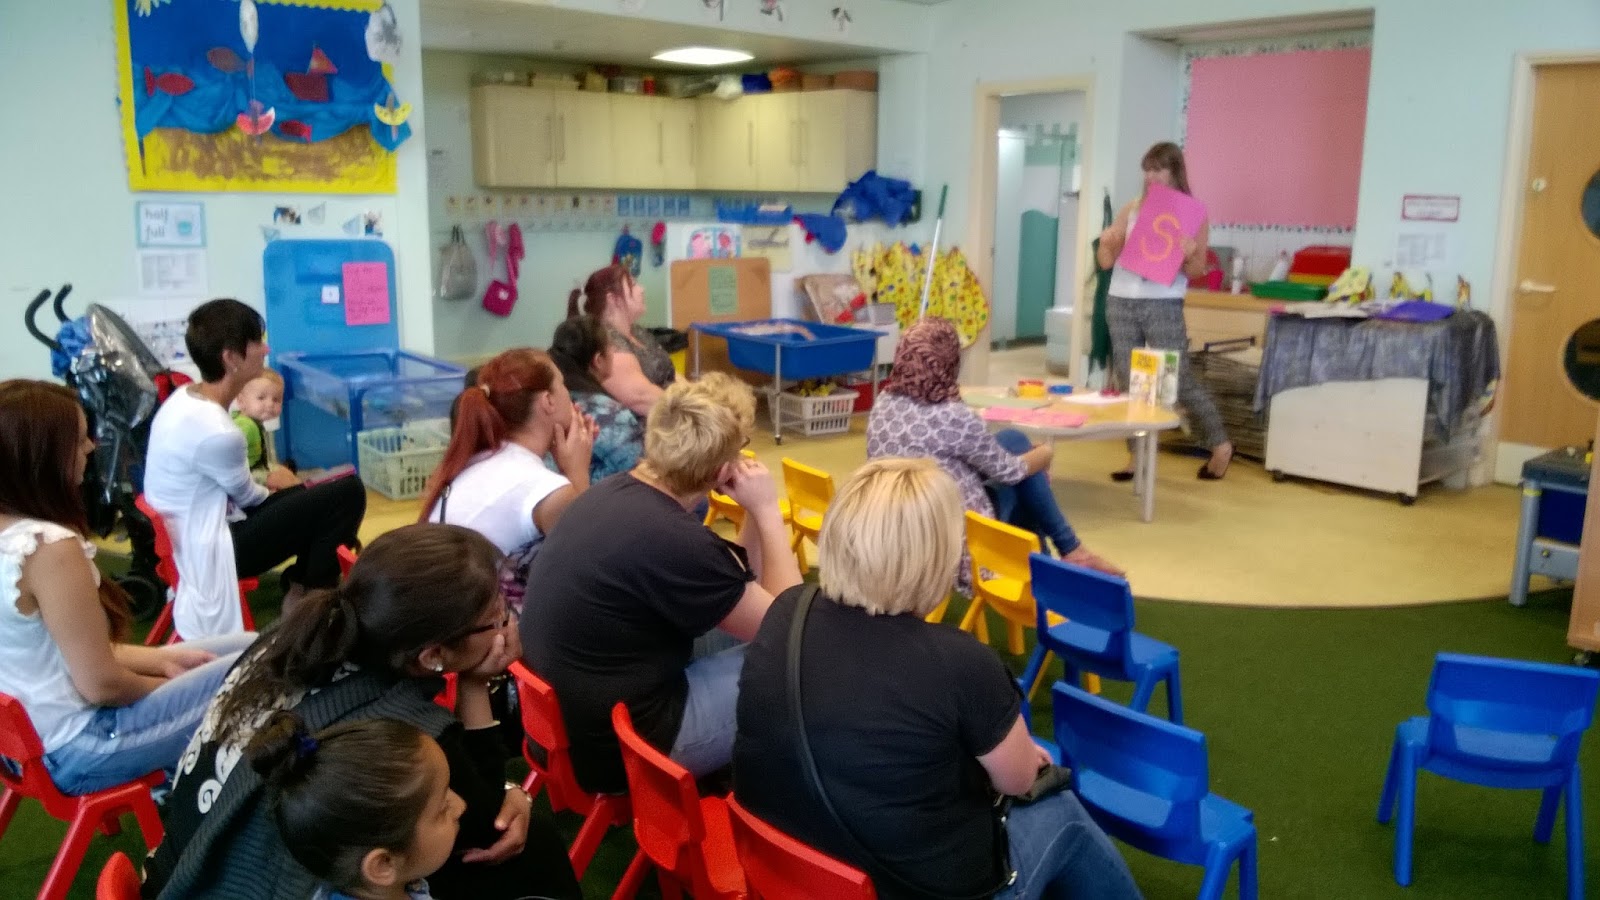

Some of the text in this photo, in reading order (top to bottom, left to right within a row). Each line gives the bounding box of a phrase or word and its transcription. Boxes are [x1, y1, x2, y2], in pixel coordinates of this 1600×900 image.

[144, 207, 169, 224] half
[144, 225, 166, 240] full
[1140, 214, 1180, 261] S
